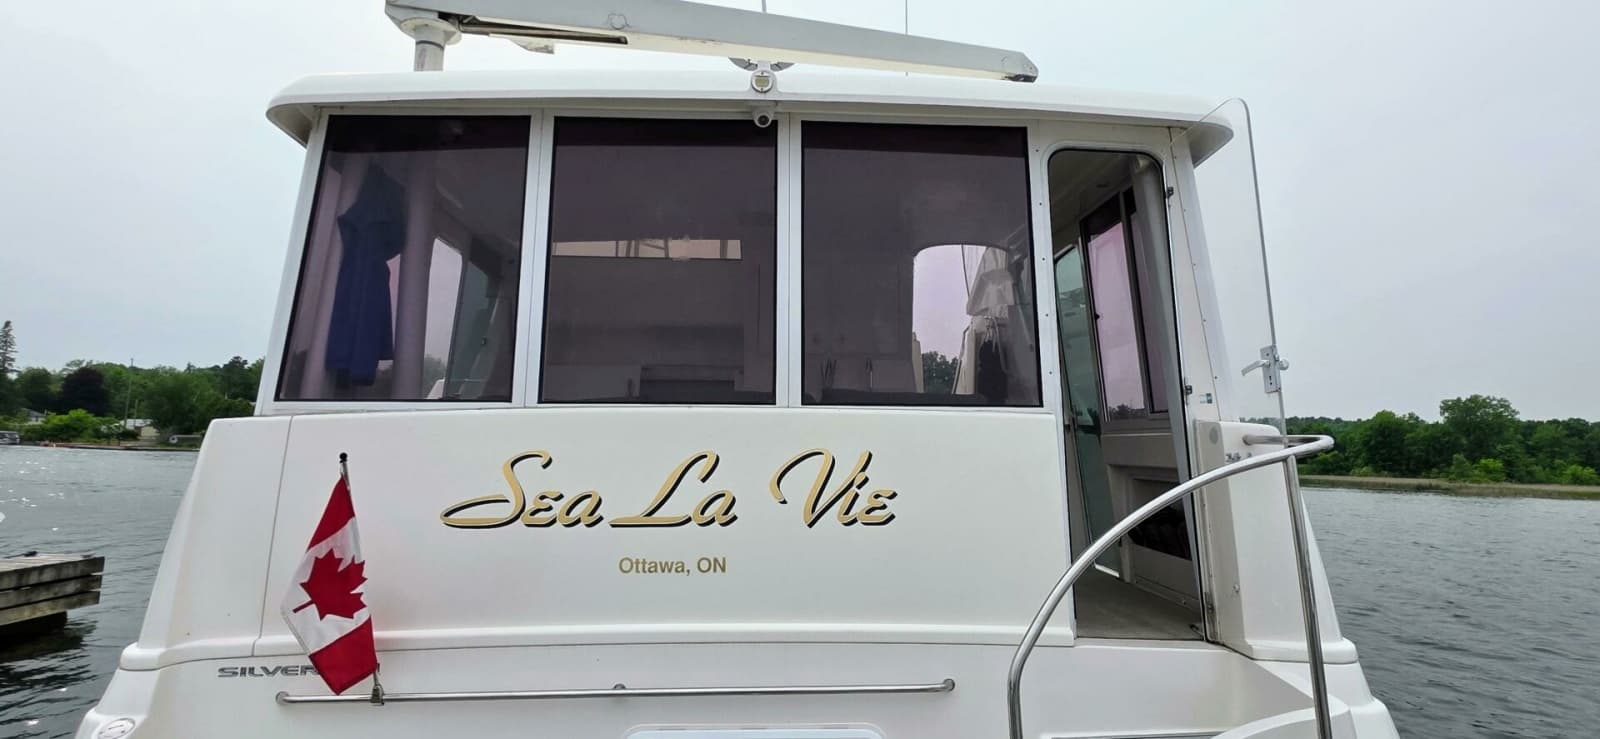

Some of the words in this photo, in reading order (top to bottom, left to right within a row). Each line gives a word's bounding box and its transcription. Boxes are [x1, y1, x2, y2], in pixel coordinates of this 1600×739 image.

[439, 449, 604, 529] Sea
[608, 449, 738, 529] La
[769, 448, 898, 529] Vie
[618, 557, 691, 576] Ottawa,
[697, 557, 727, 573] ON
[217, 664, 321, 678] SILVER
